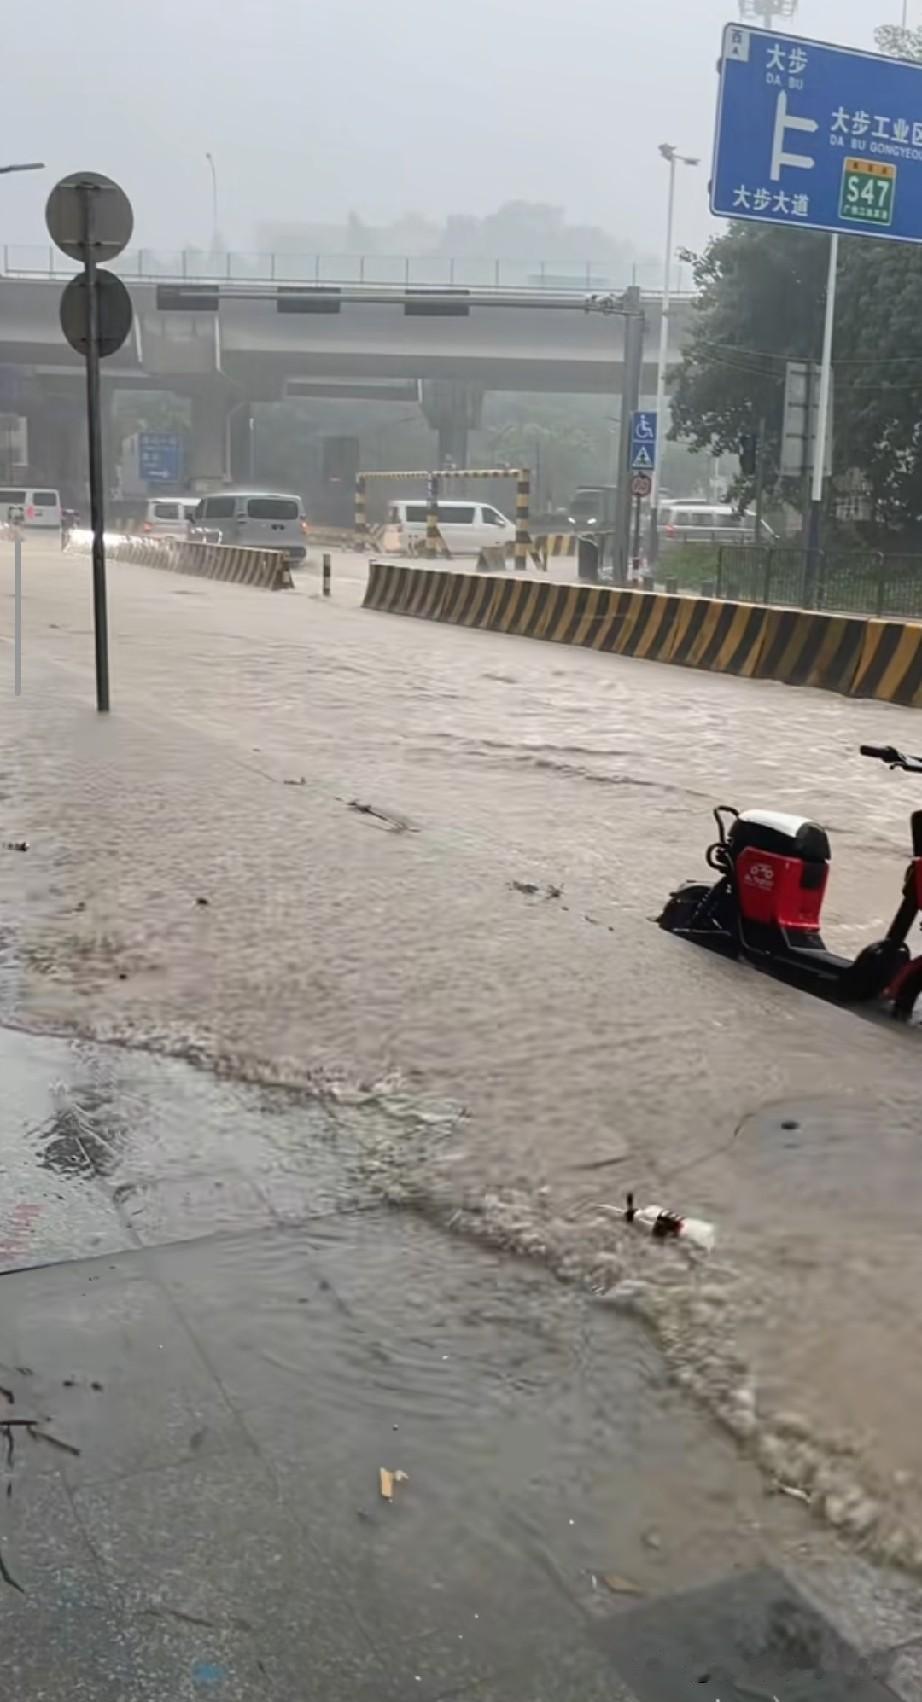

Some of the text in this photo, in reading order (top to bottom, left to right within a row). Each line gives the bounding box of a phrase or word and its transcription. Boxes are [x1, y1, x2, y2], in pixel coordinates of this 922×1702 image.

[766, 43, 808, 74] 大步
[766, 72, 781, 87] DA
[830, 134, 844, 147] DA
[732, 184, 809, 217] 大步大道
[847, 175, 890, 207] S47
